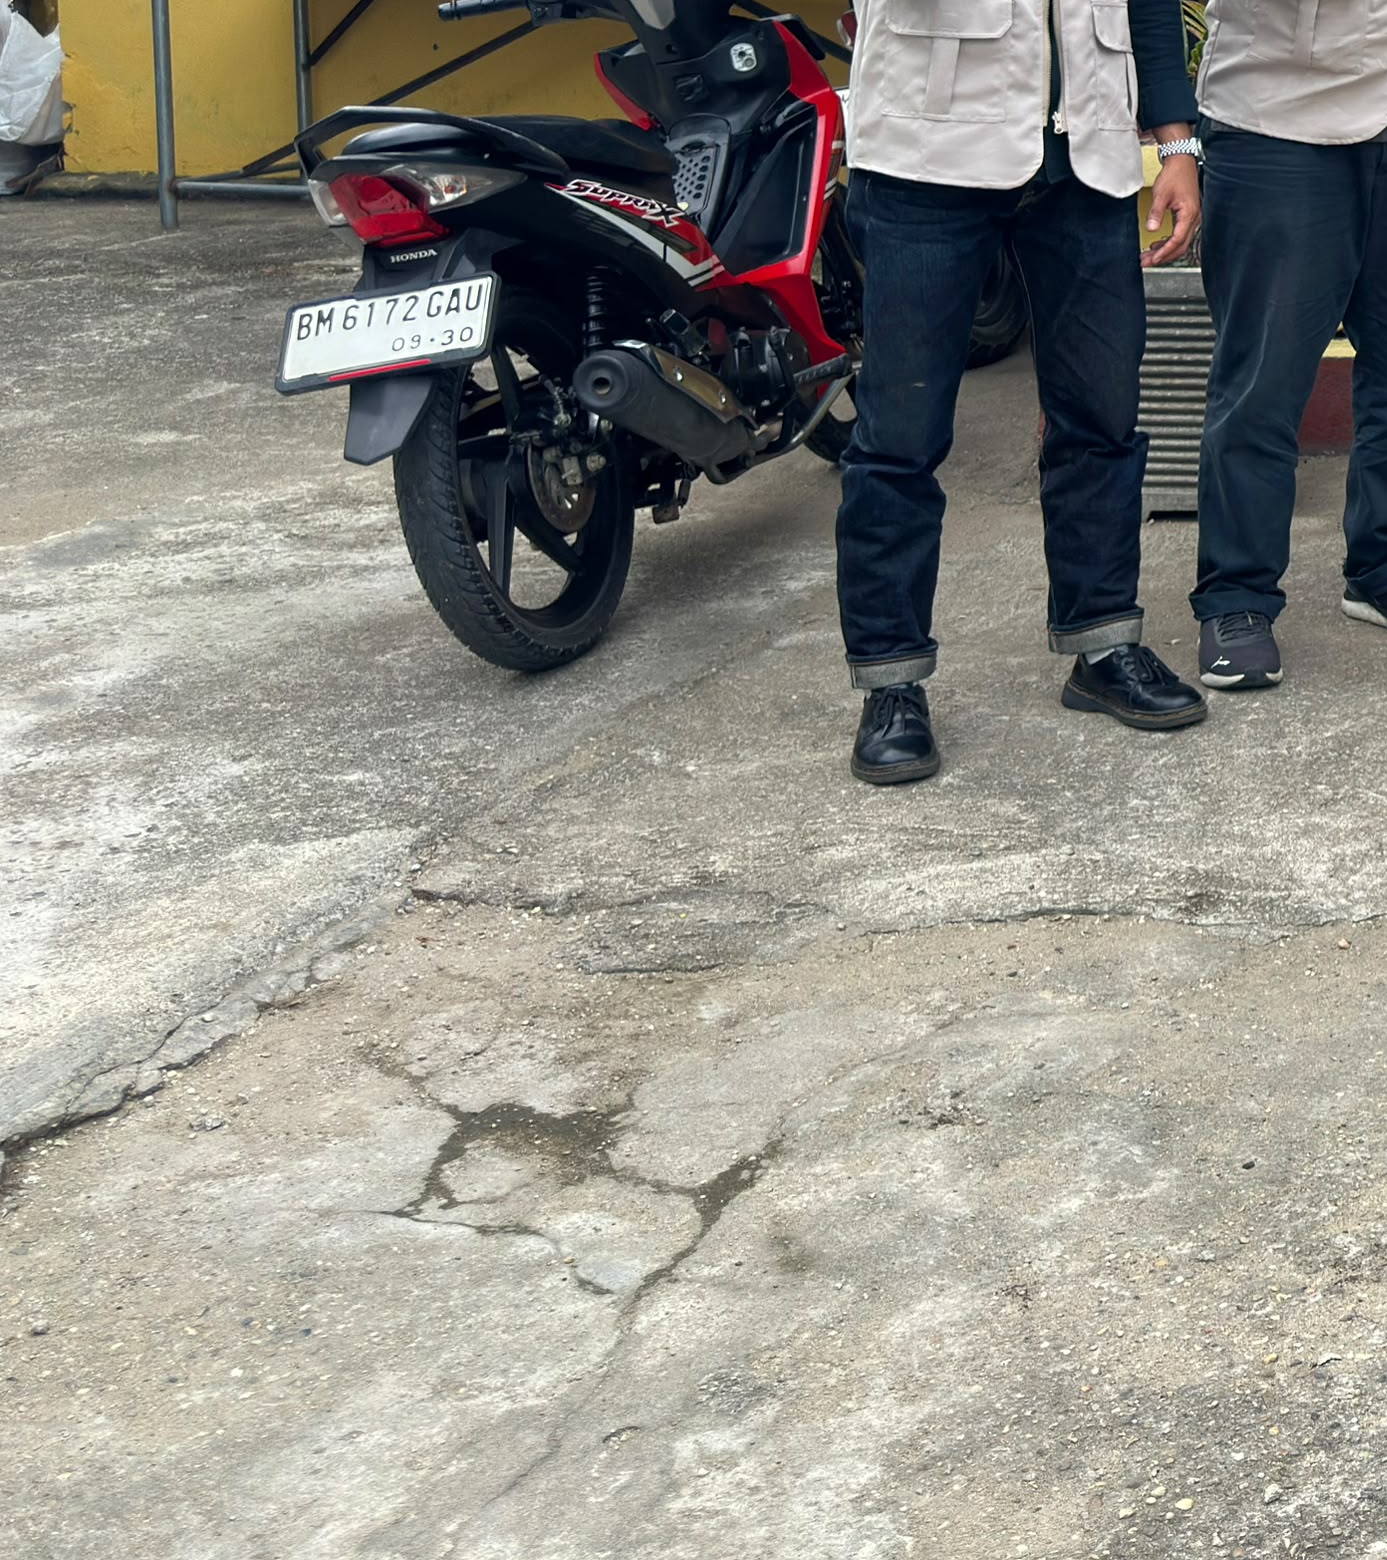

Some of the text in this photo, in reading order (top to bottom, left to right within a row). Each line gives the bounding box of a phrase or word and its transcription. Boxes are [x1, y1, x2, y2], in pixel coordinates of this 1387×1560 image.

[390, 248, 438, 263] HONDA
[297, 284, 484, 341] BM 6172 GAU
